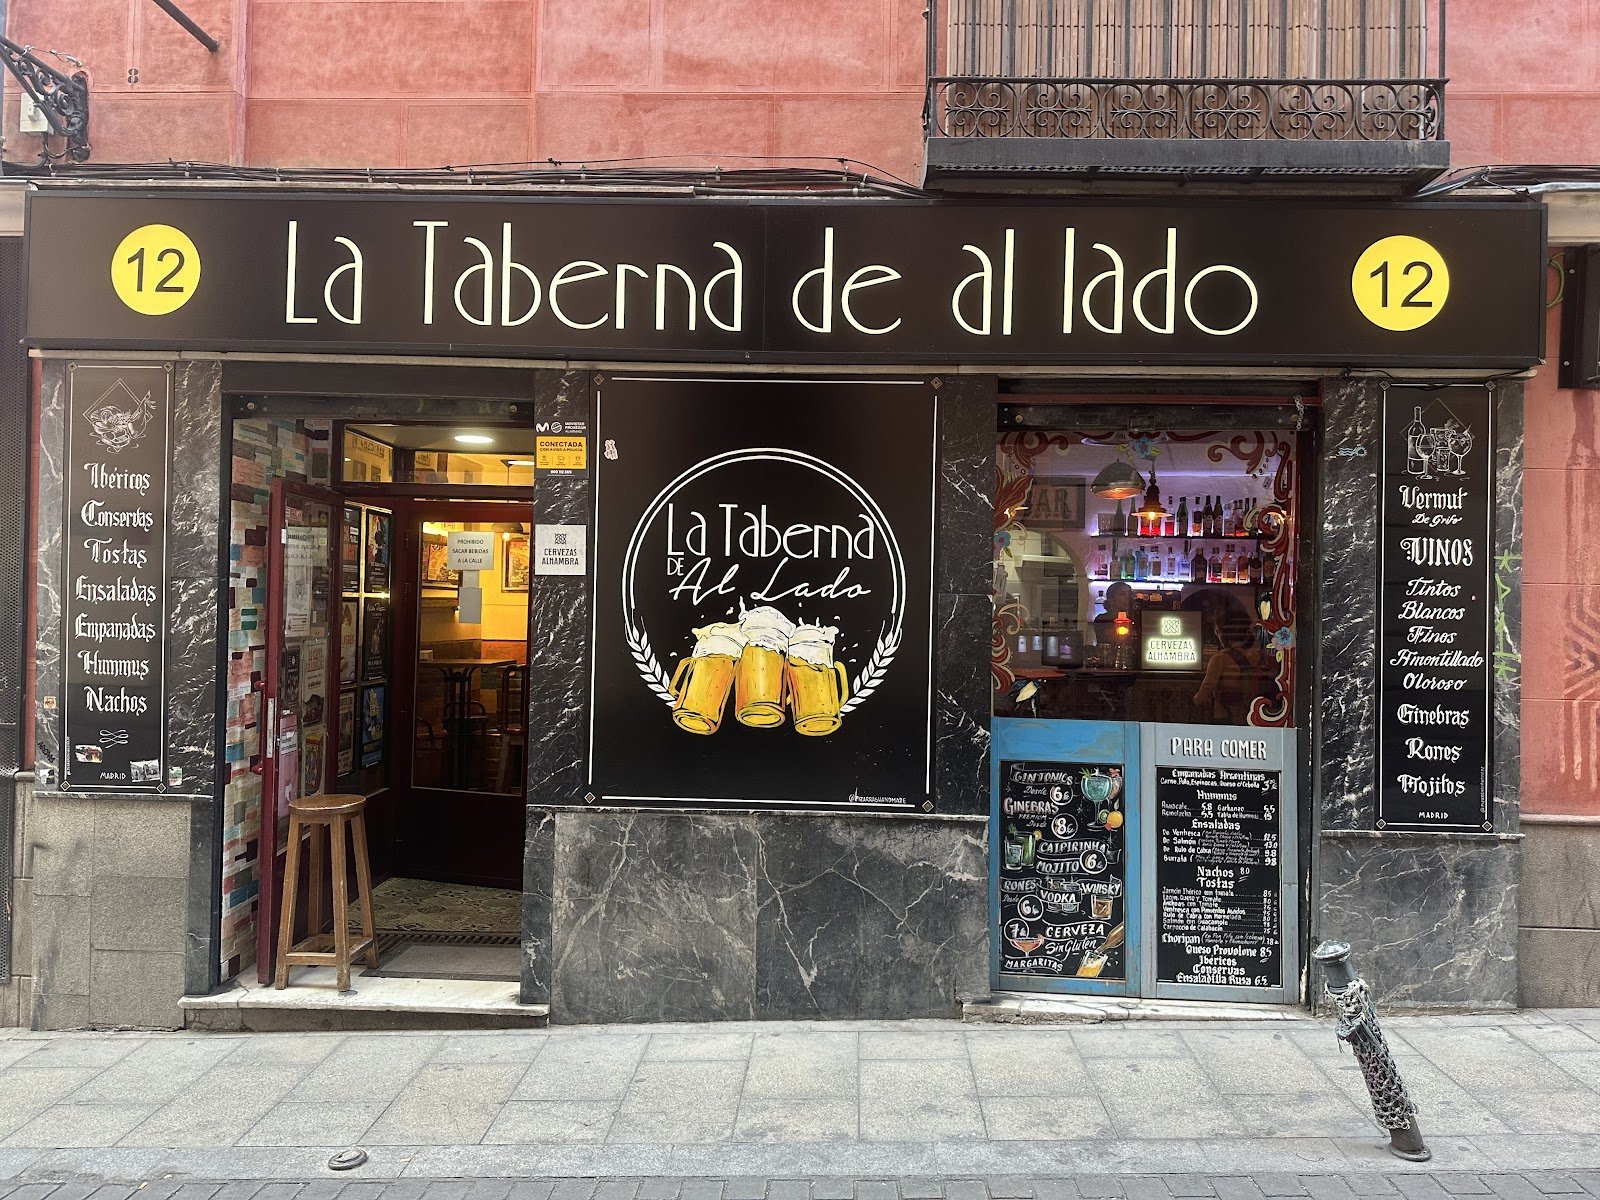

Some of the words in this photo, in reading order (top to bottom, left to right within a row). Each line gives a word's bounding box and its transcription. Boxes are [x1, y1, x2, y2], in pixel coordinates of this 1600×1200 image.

[127, 247, 185, 293] 12
[285, 220, 363, 325] La
[413, 221, 743, 332] Taberna
[793, 227, 902, 336] de
[952, 229, 1015, 336] al
[1062, 227, 1259, 336] lado
[1368, 261, 1433, 308] 12
[84, 463, 151, 496] Ibéricos
[1399, 485, 1468, 510] Vermut
[80, 500, 154, 532] Conservas
[1412, 512, 1430, 524] De
[1429, 514, 1463, 527] Grifo
[667, 503, 707, 556] La
[719, 504, 875, 559] Taberna
[83, 538, 148, 569] Tostas
[544, 548, 577, 556] CERVEZAS
[1400, 537, 1473, 567] VINOS
[541, 557, 579, 566] ALHAMBRA
[667, 557, 684, 576] DE
[669, 557, 740, 606] Al
[750, 557, 872, 602] Lado
[1406, 577, 1461, 597] Tintos
[75, 575, 157, 607] Ensaladas
[1398, 601, 1466, 620] Blancos
[75, 612, 156, 643] Empanadas
[1407, 625, 1457, 644] Finos
[1150, 640, 1193, 650] CERVEZAS
[1147, 651, 1196, 661] ALHAMBRA
[1390, 649, 1485, 667] Amontillado
[77, 650, 150, 680] Hummus
[1403, 672, 1467, 690] Oloroso
[83, 686, 147, 716] Nachos
[1397, 703, 1470, 729] Ginebras
[1171, 737, 1213, 757] PARA
[1220, 739, 1267, 760] COMER
[1405, 737, 1463, 763] Rones
[100, 772, 126, 780] MADRID
[1172, 769, 1216, 779] Empanadas
[1023, 786, 1048, 796] Desde
[1397, 773, 1466, 797] Mojitos
[1196, 790, 1237, 800] Hummus
[1003, 797, 1059, 816] GINEBRAS
[1419, 811, 1449, 819] MADRID
[1026, 820, 1047, 828] Desde
[1191, 818, 1240, 830] Ensaladas
[1040, 841, 1106, 853] CAIPIRINHA
[1172, 837, 1196, 845] Salmón
[1036, 860, 1080, 874] MOJITO
[1197, 865, 1234, 878] Nachos
[1004, 879, 1037, 891] RONES
[1081, 882, 1121, 895] WHISKY
[1196, 877, 1236, 889] Tostas
[1040, 889, 1076, 903] VODKA
[1045, 923, 1105, 938] CERVEZA
[1162, 932, 1200, 946] Choripan
[1185, 944, 1212, 955] Queso
[1213, 944, 1257, 957] Provolone
[1005, 958, 1063, 972] MARGARITAS
[1199, 954, 1237, 966] Ibéricos
[1192, 964, 1246, 975] Conservas
[1176, 972, 1227, 984] Ensaladilla
[1228, 975, 1252, 985] Rusa
